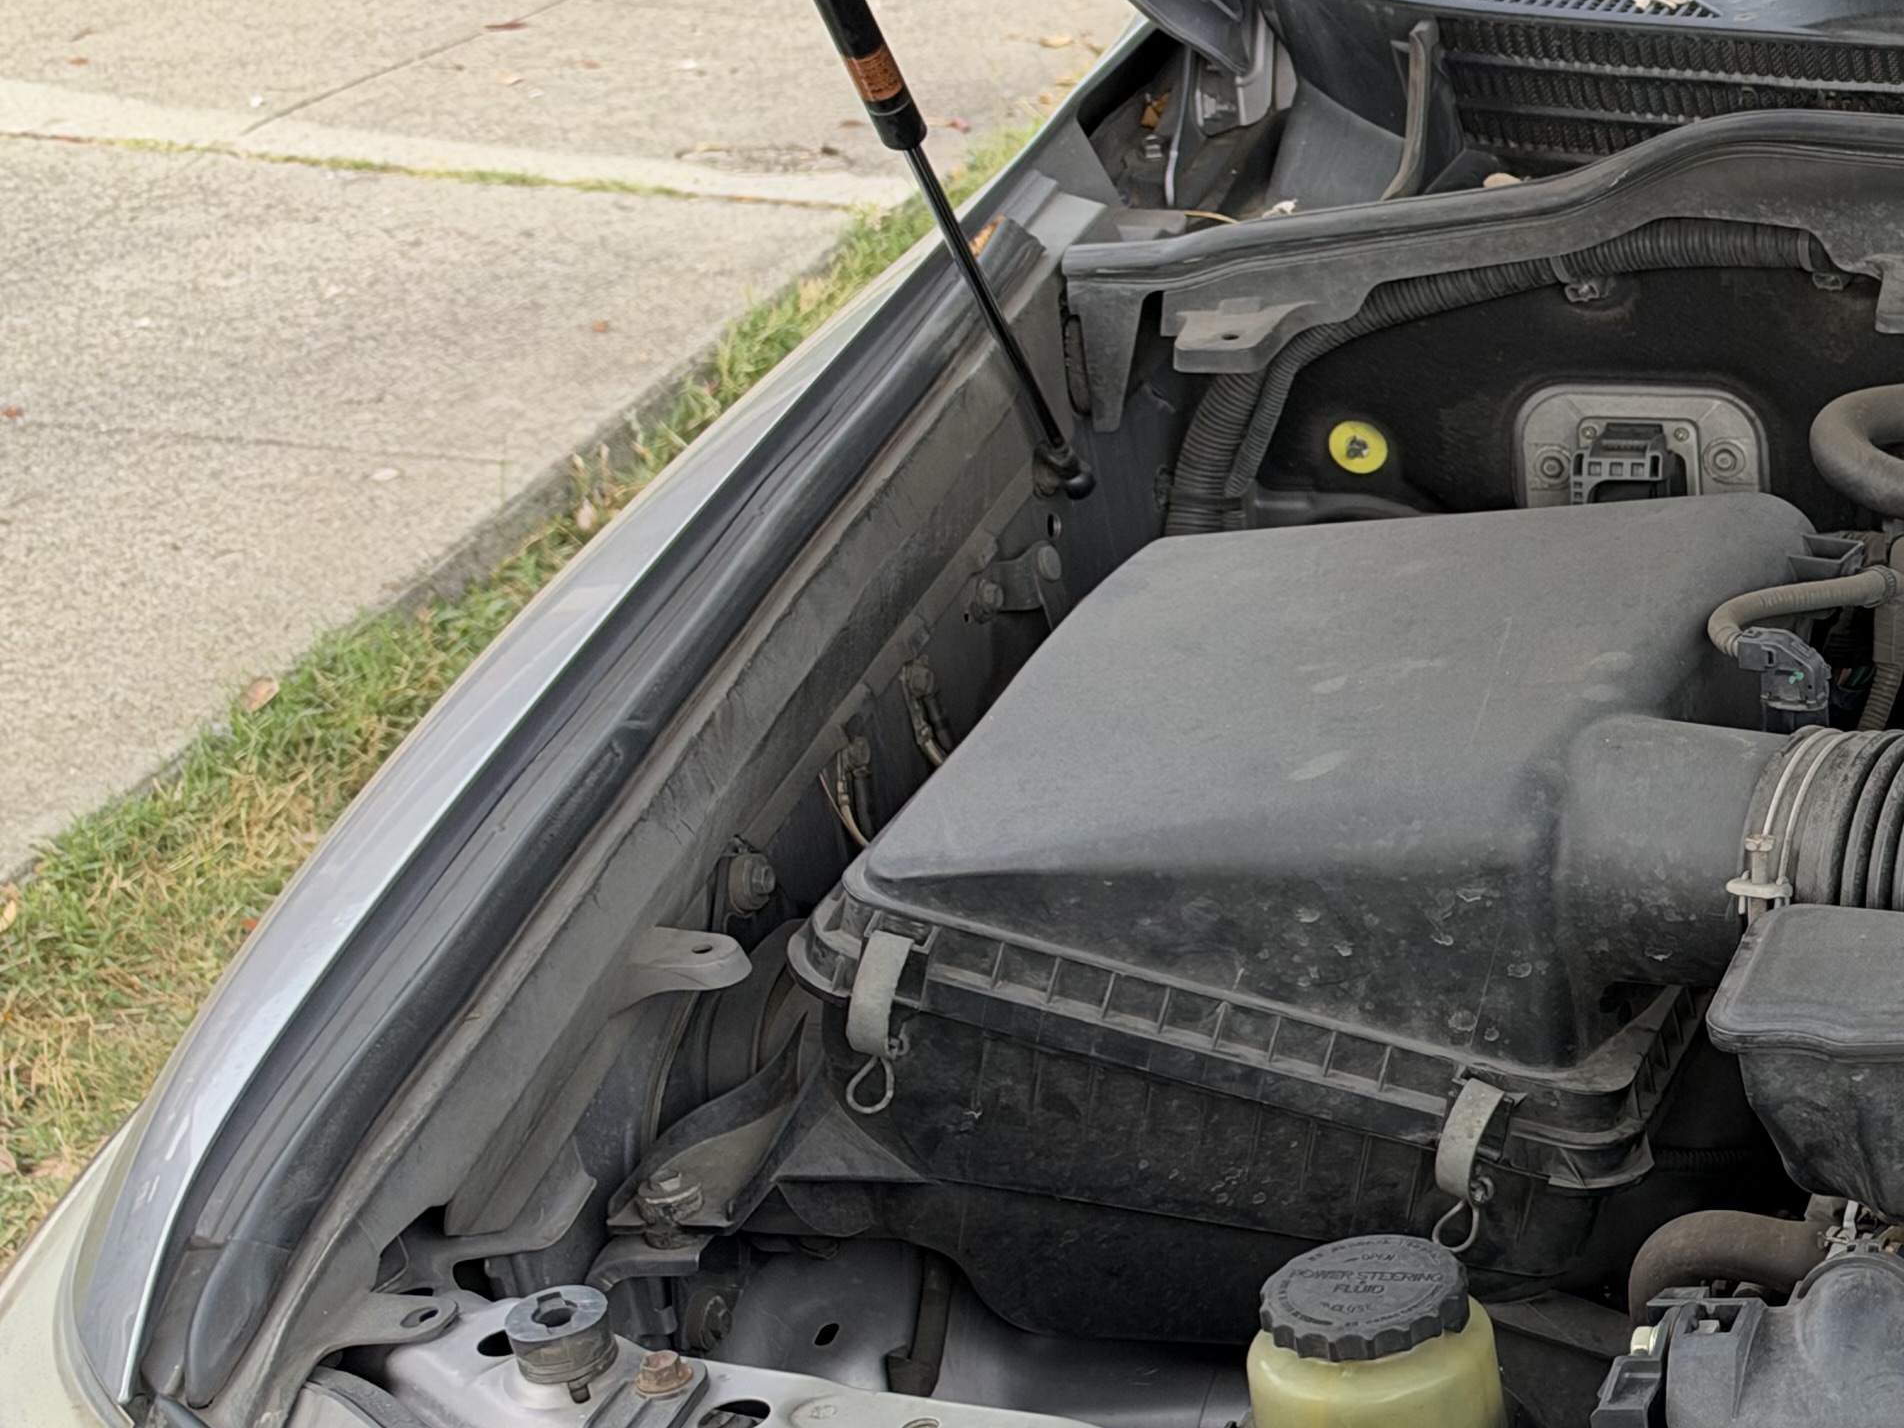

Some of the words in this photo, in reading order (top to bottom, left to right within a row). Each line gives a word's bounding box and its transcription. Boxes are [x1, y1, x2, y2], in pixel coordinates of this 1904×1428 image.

[1289, 1269, 1352, 1280] POWER
[1357, 1271, 1444, 1282] STEERING
[1332, 1283, 1385, 1294] FLUID
